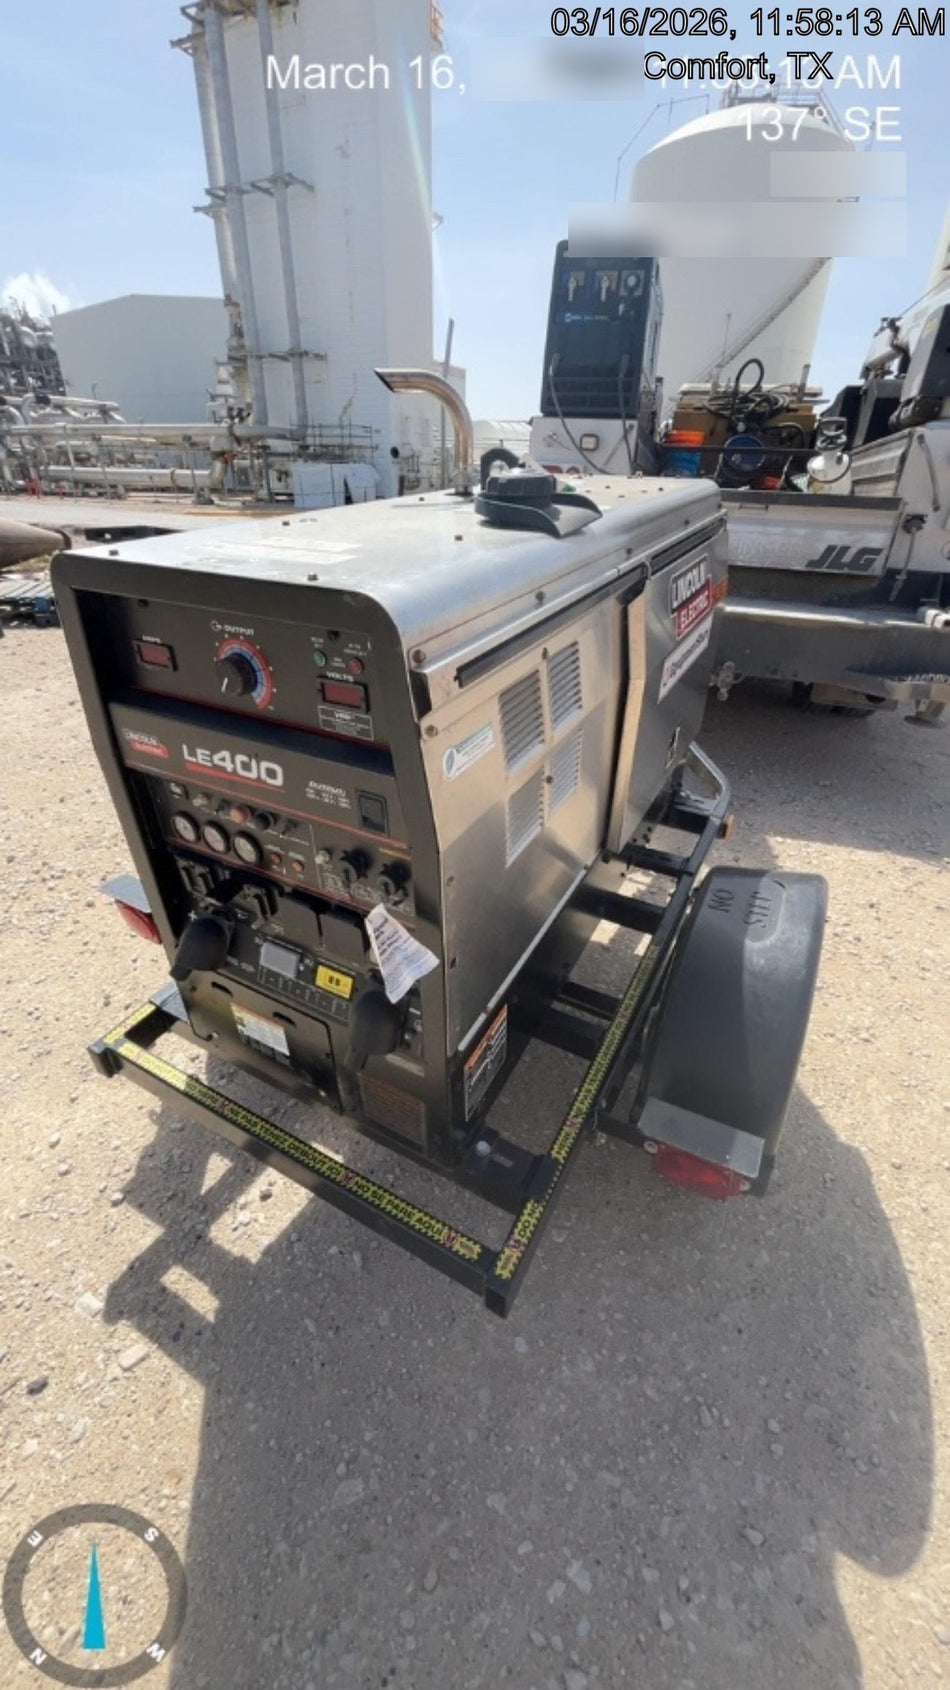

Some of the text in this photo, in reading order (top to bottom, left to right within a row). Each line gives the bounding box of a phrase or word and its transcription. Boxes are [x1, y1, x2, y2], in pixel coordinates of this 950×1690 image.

[805, 544, 884, 572] JLG
[672, 562, 708, 610] LINCOLN
[223, 624, 254, 636] OUTPUT
[182, 744, 283, 787] LE400
[707, 889, 734, 914] NO
[286, 1140, 327, 1168] DEBOUT
[353, 1179, 370, 1193] NO
[370, 1189, 386, 1203] SE
[385, 1198, 414, 1219] PARE
[414, 1215, 443, 1236] AQUI
[516, 1218, 531, 1238] DO
